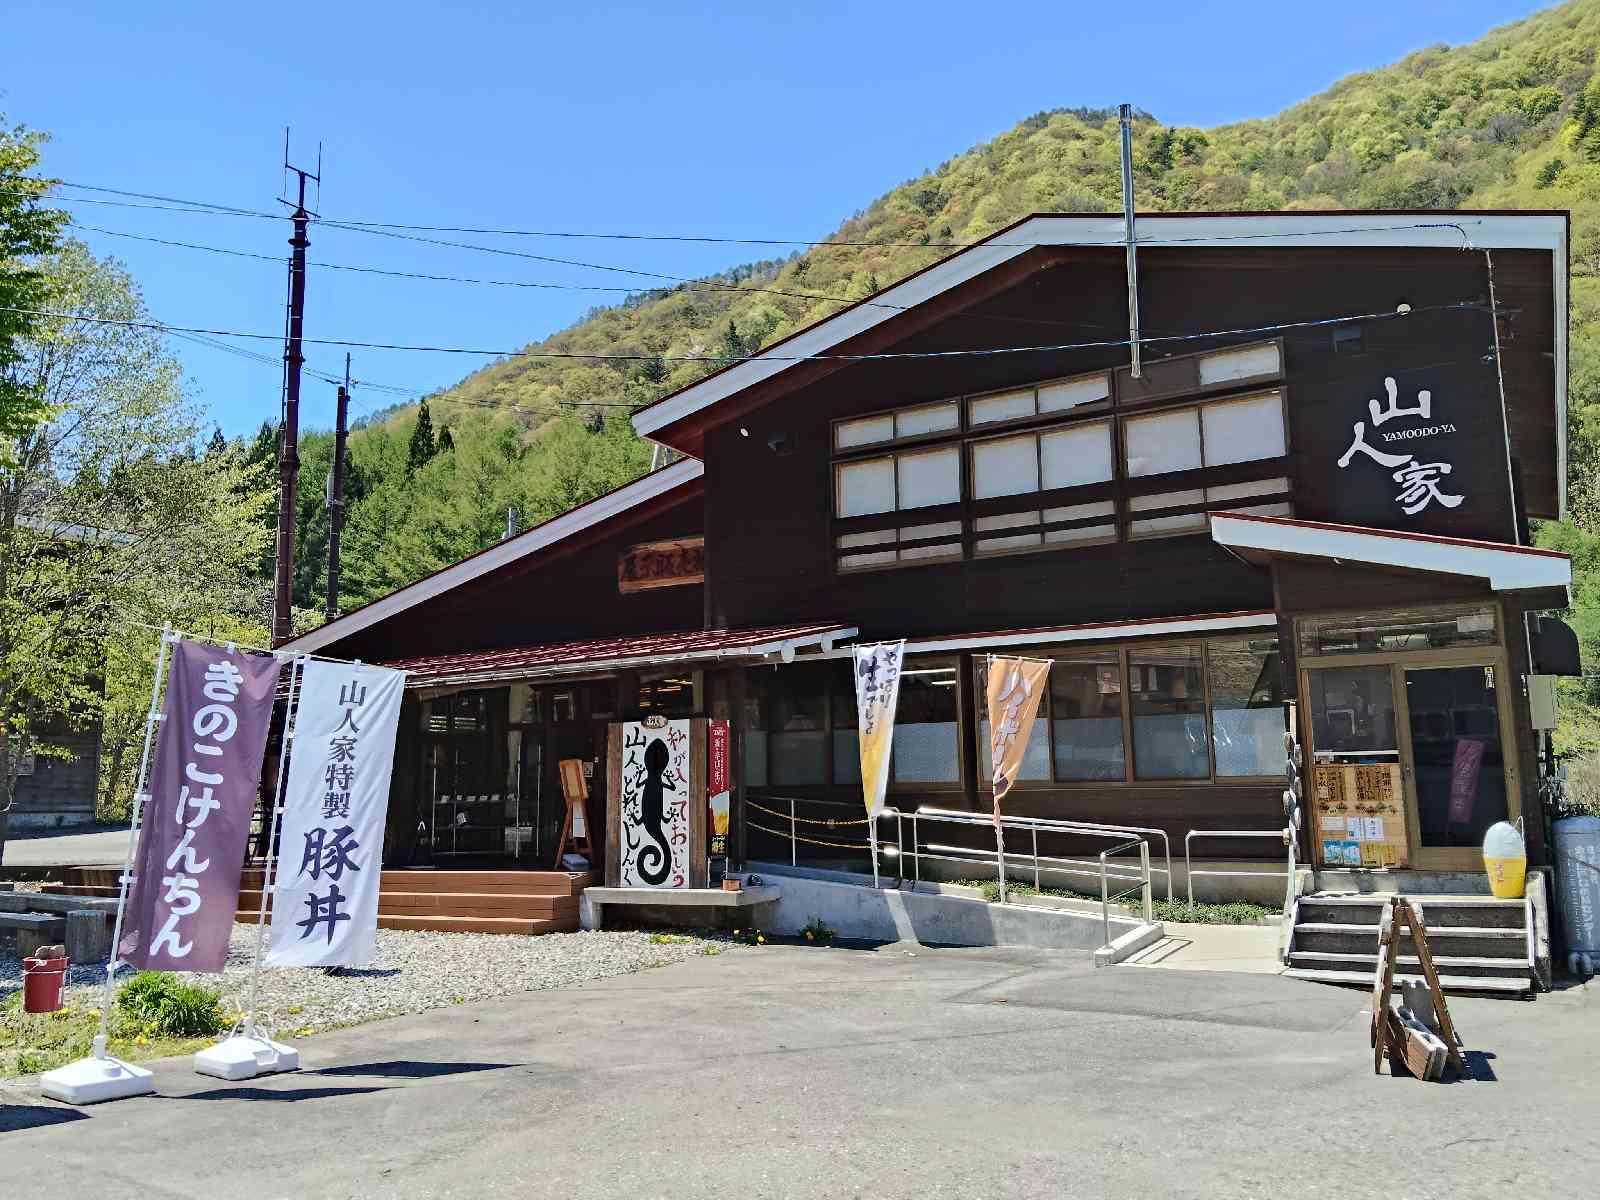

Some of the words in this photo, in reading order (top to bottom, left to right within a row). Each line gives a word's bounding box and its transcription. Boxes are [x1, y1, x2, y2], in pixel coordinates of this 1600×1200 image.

[1337, 376, 1464, 515] 山人家
[1382, 423, 1457, 442] YAMOODO-YA
[149, 660, 244, 959] きのこけんちん
[321, 679, 367, 820] 山人家特製
[297, 825, 362, 947] 豚丼
